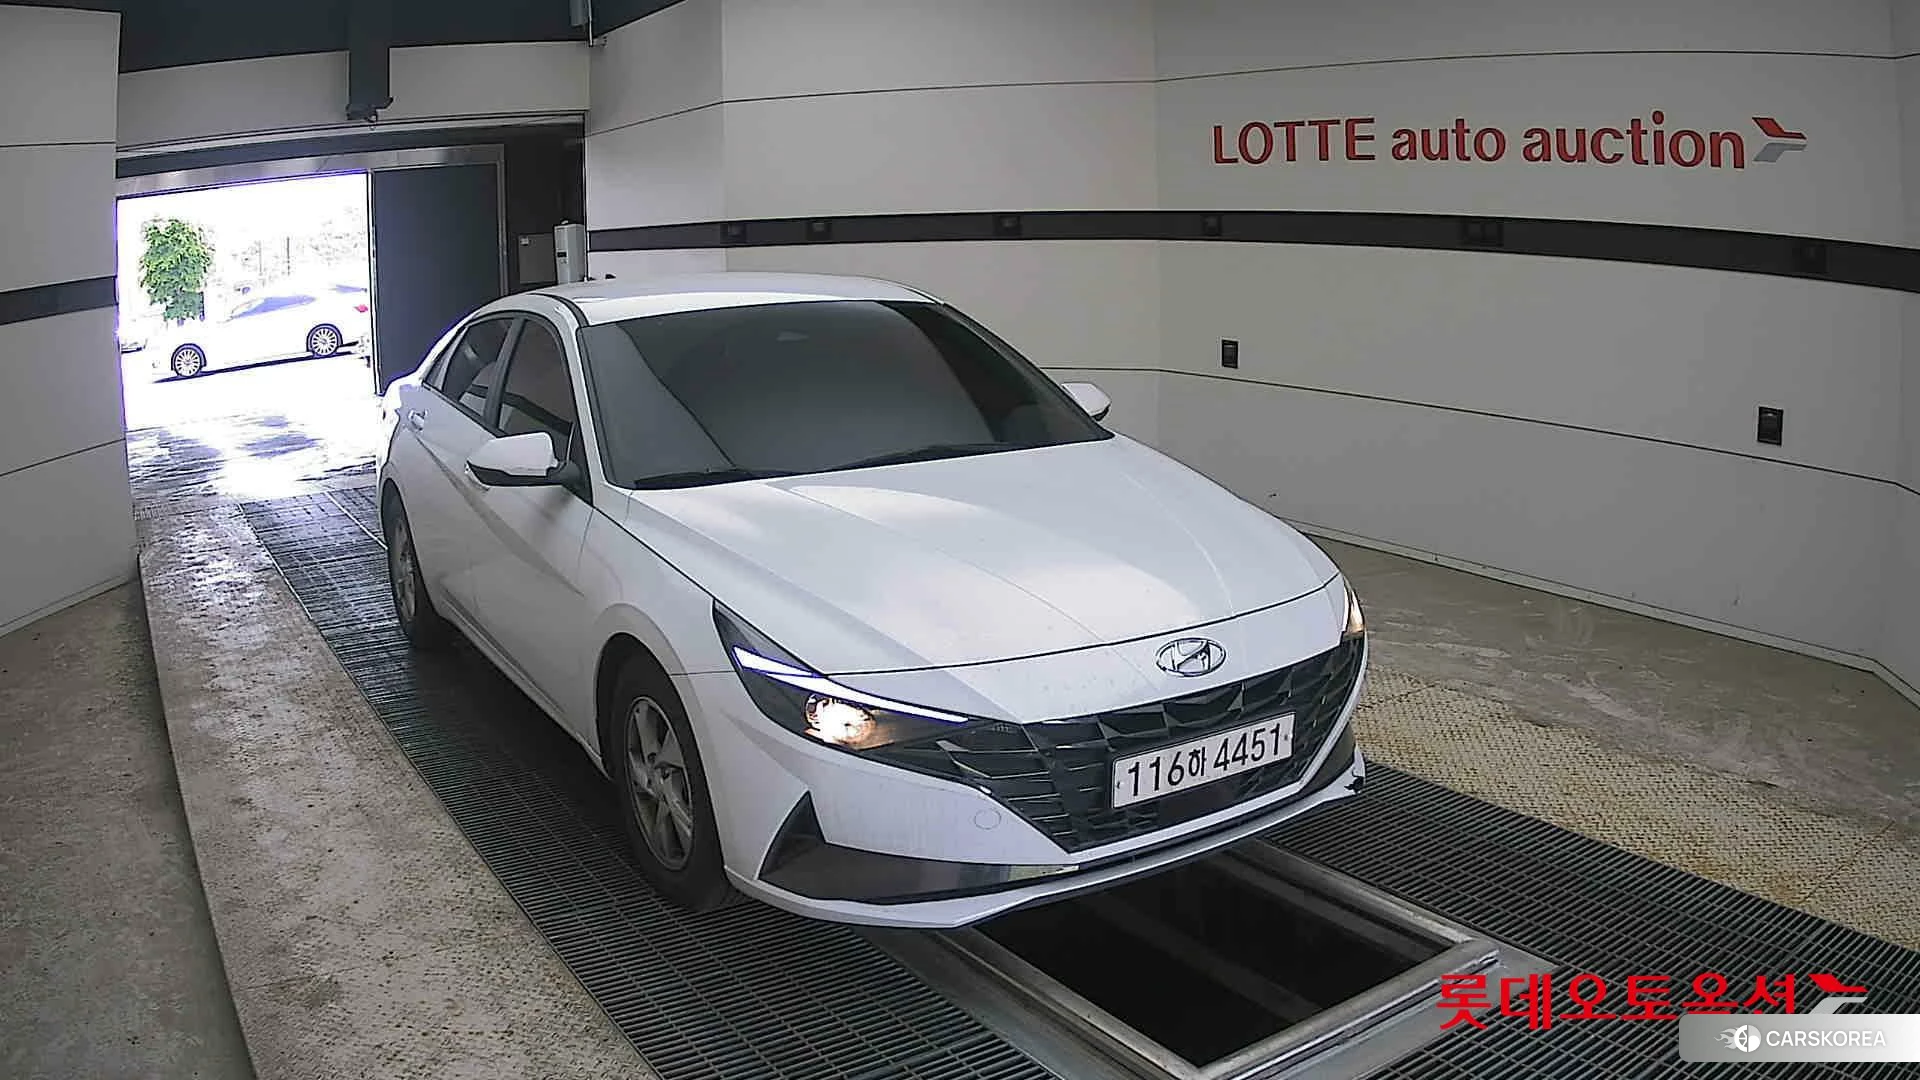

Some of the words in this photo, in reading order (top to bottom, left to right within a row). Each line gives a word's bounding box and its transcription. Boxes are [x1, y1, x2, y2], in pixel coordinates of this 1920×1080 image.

[1212, 117, 1376, 165] LOTTE
[1391, 118, 1507, 163] auto
[1522, 110, 1746, 169] auction
[1213, 723, 1281, 771] 4451
